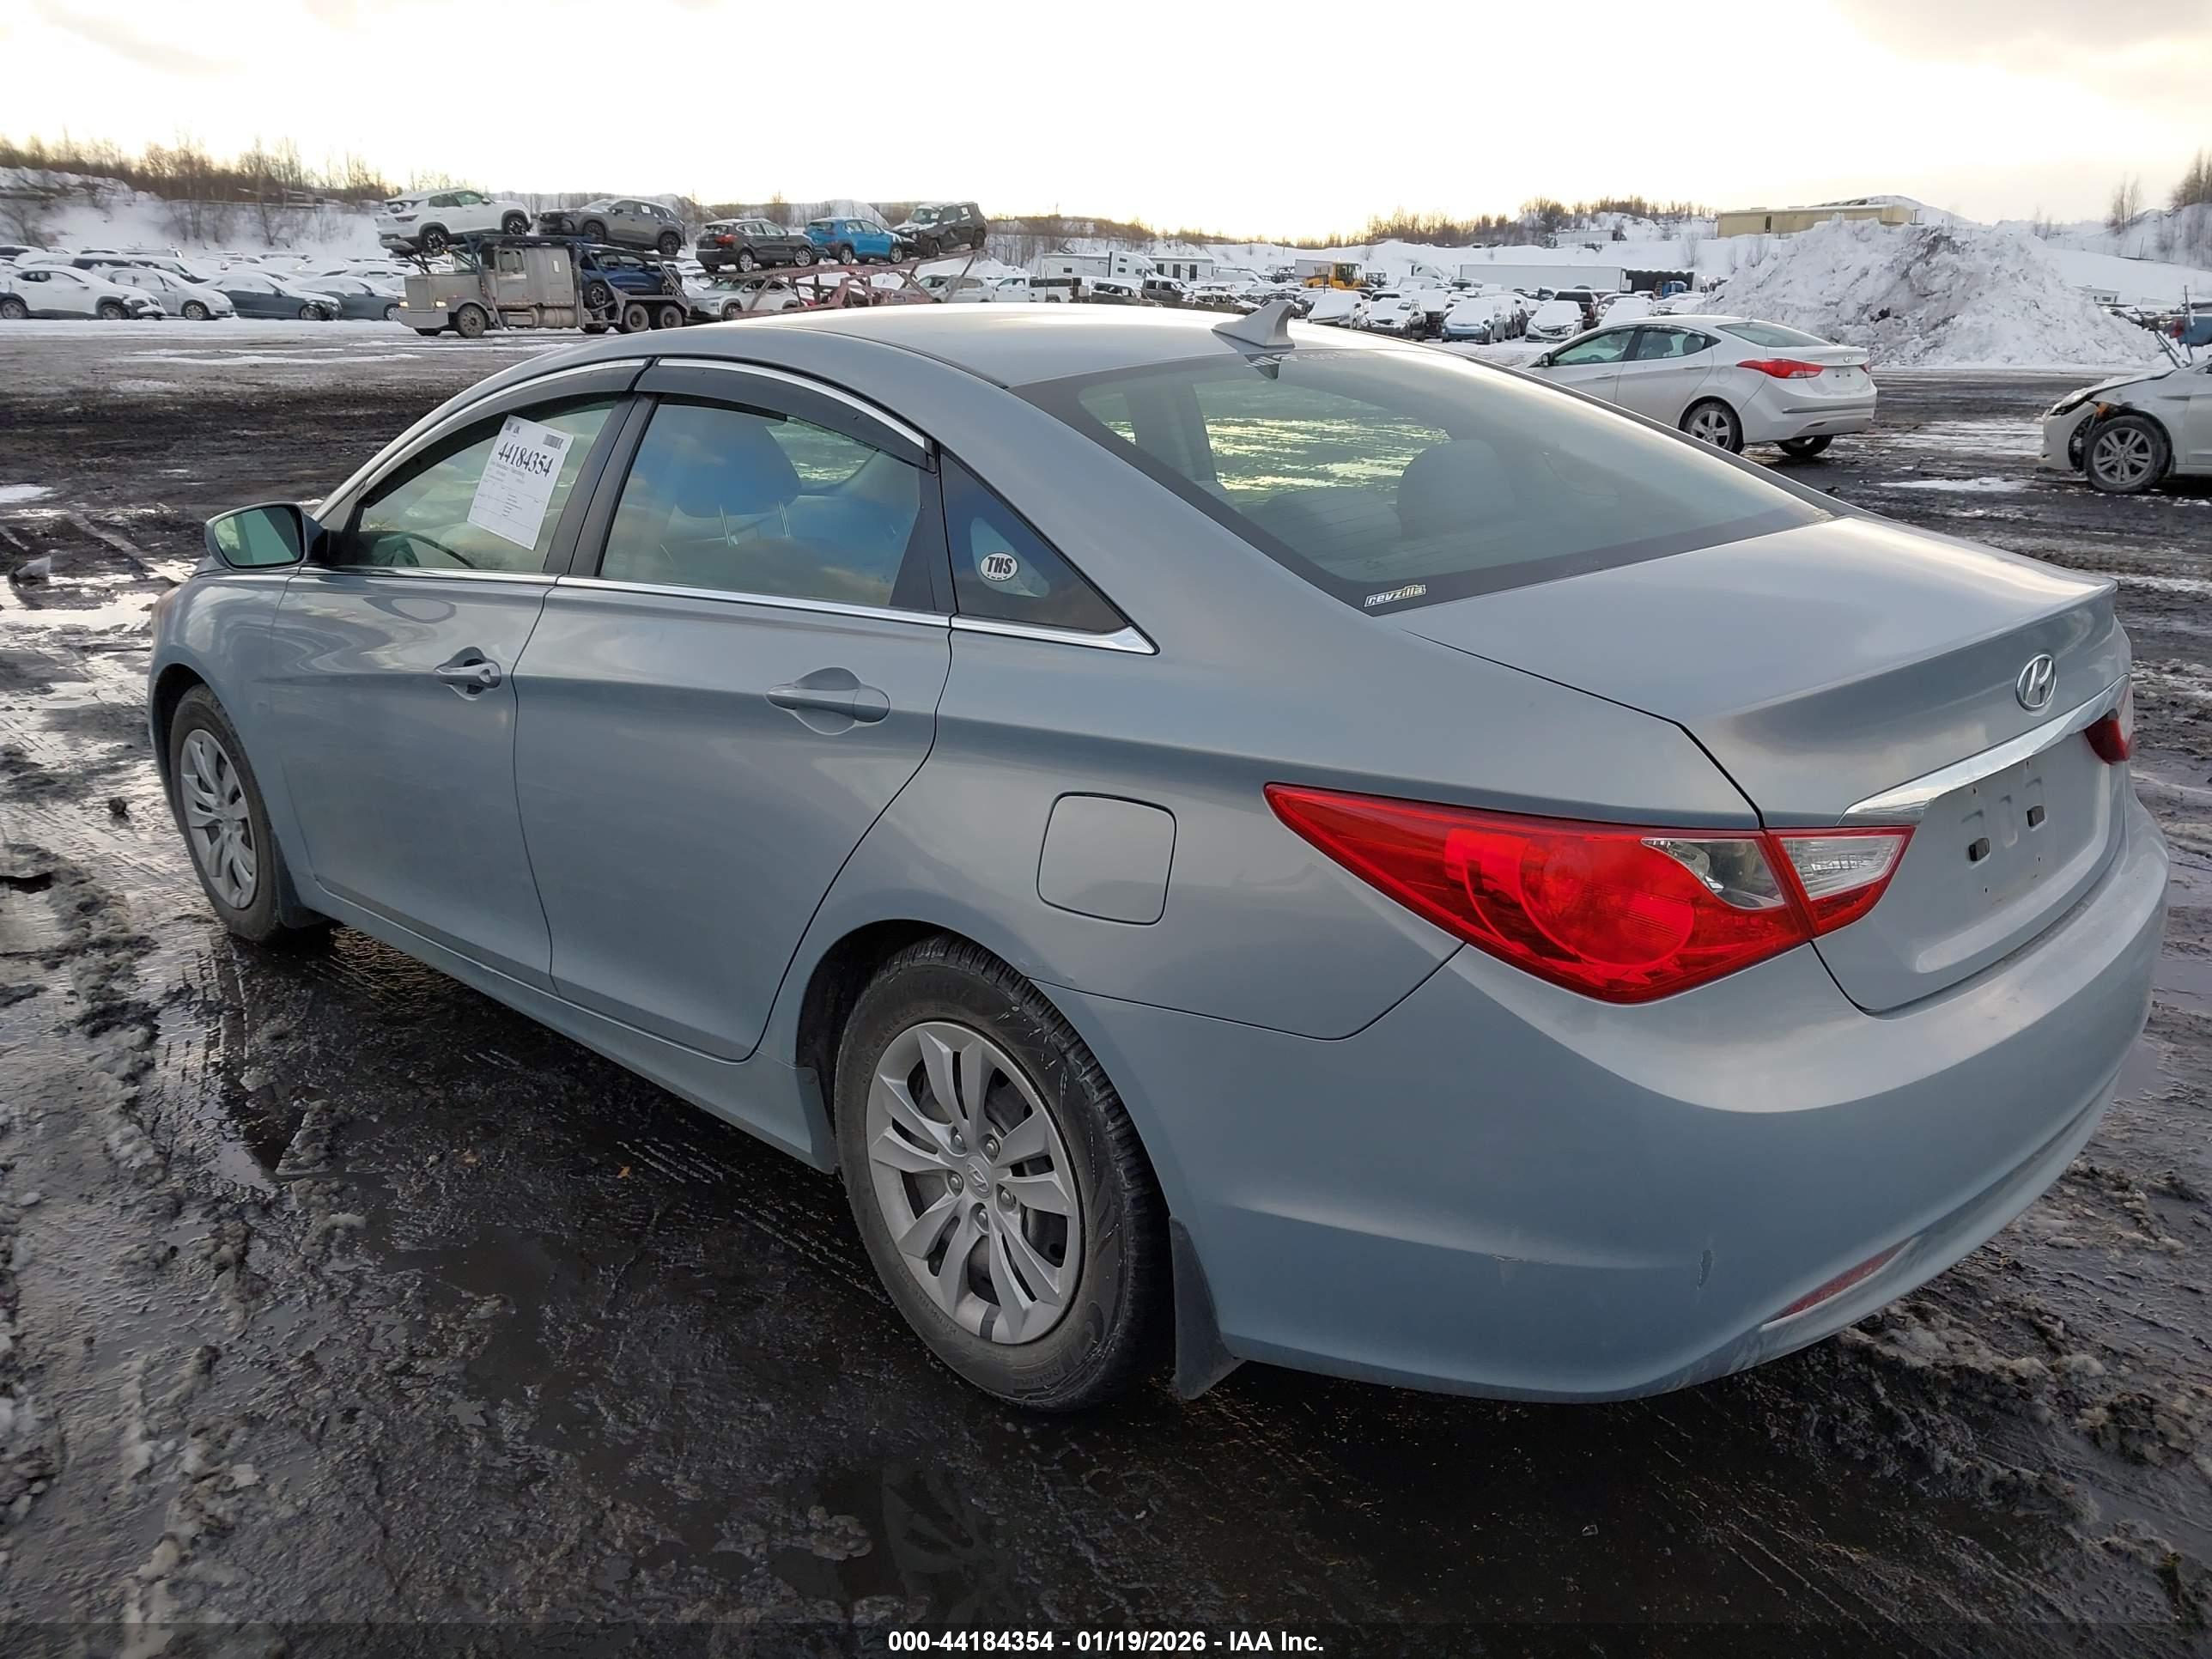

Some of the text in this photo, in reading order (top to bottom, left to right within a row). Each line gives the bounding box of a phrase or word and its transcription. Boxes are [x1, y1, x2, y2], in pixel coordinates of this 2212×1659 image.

[498, 441, 554, 477] 44184354
[988, 556, 1013, 574] THS
[1368, 586, 1424, 605] revzilla
